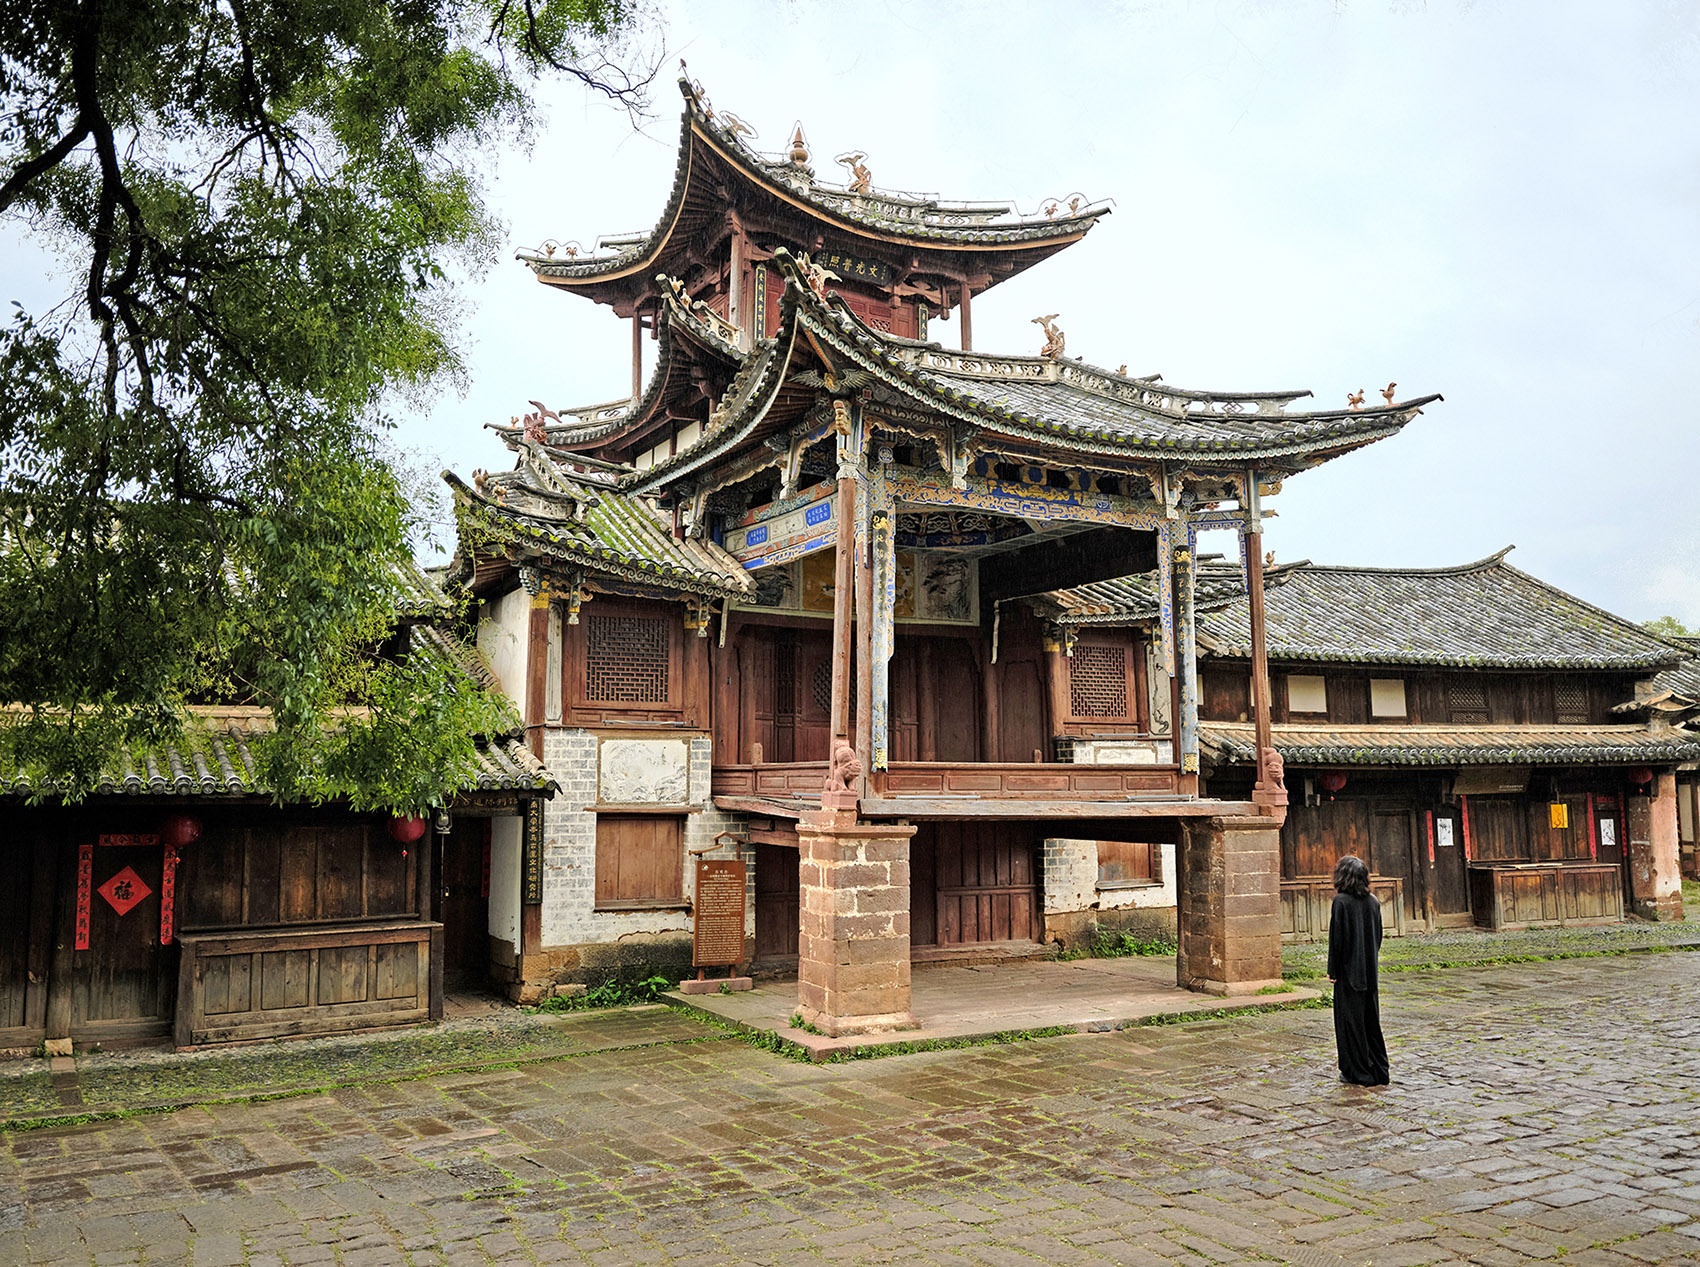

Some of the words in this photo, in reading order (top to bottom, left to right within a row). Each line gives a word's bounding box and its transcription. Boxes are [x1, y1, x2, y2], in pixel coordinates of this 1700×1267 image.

[829, 254, 879, 279] 文光普照
[113, 880, 135, 900] 福
